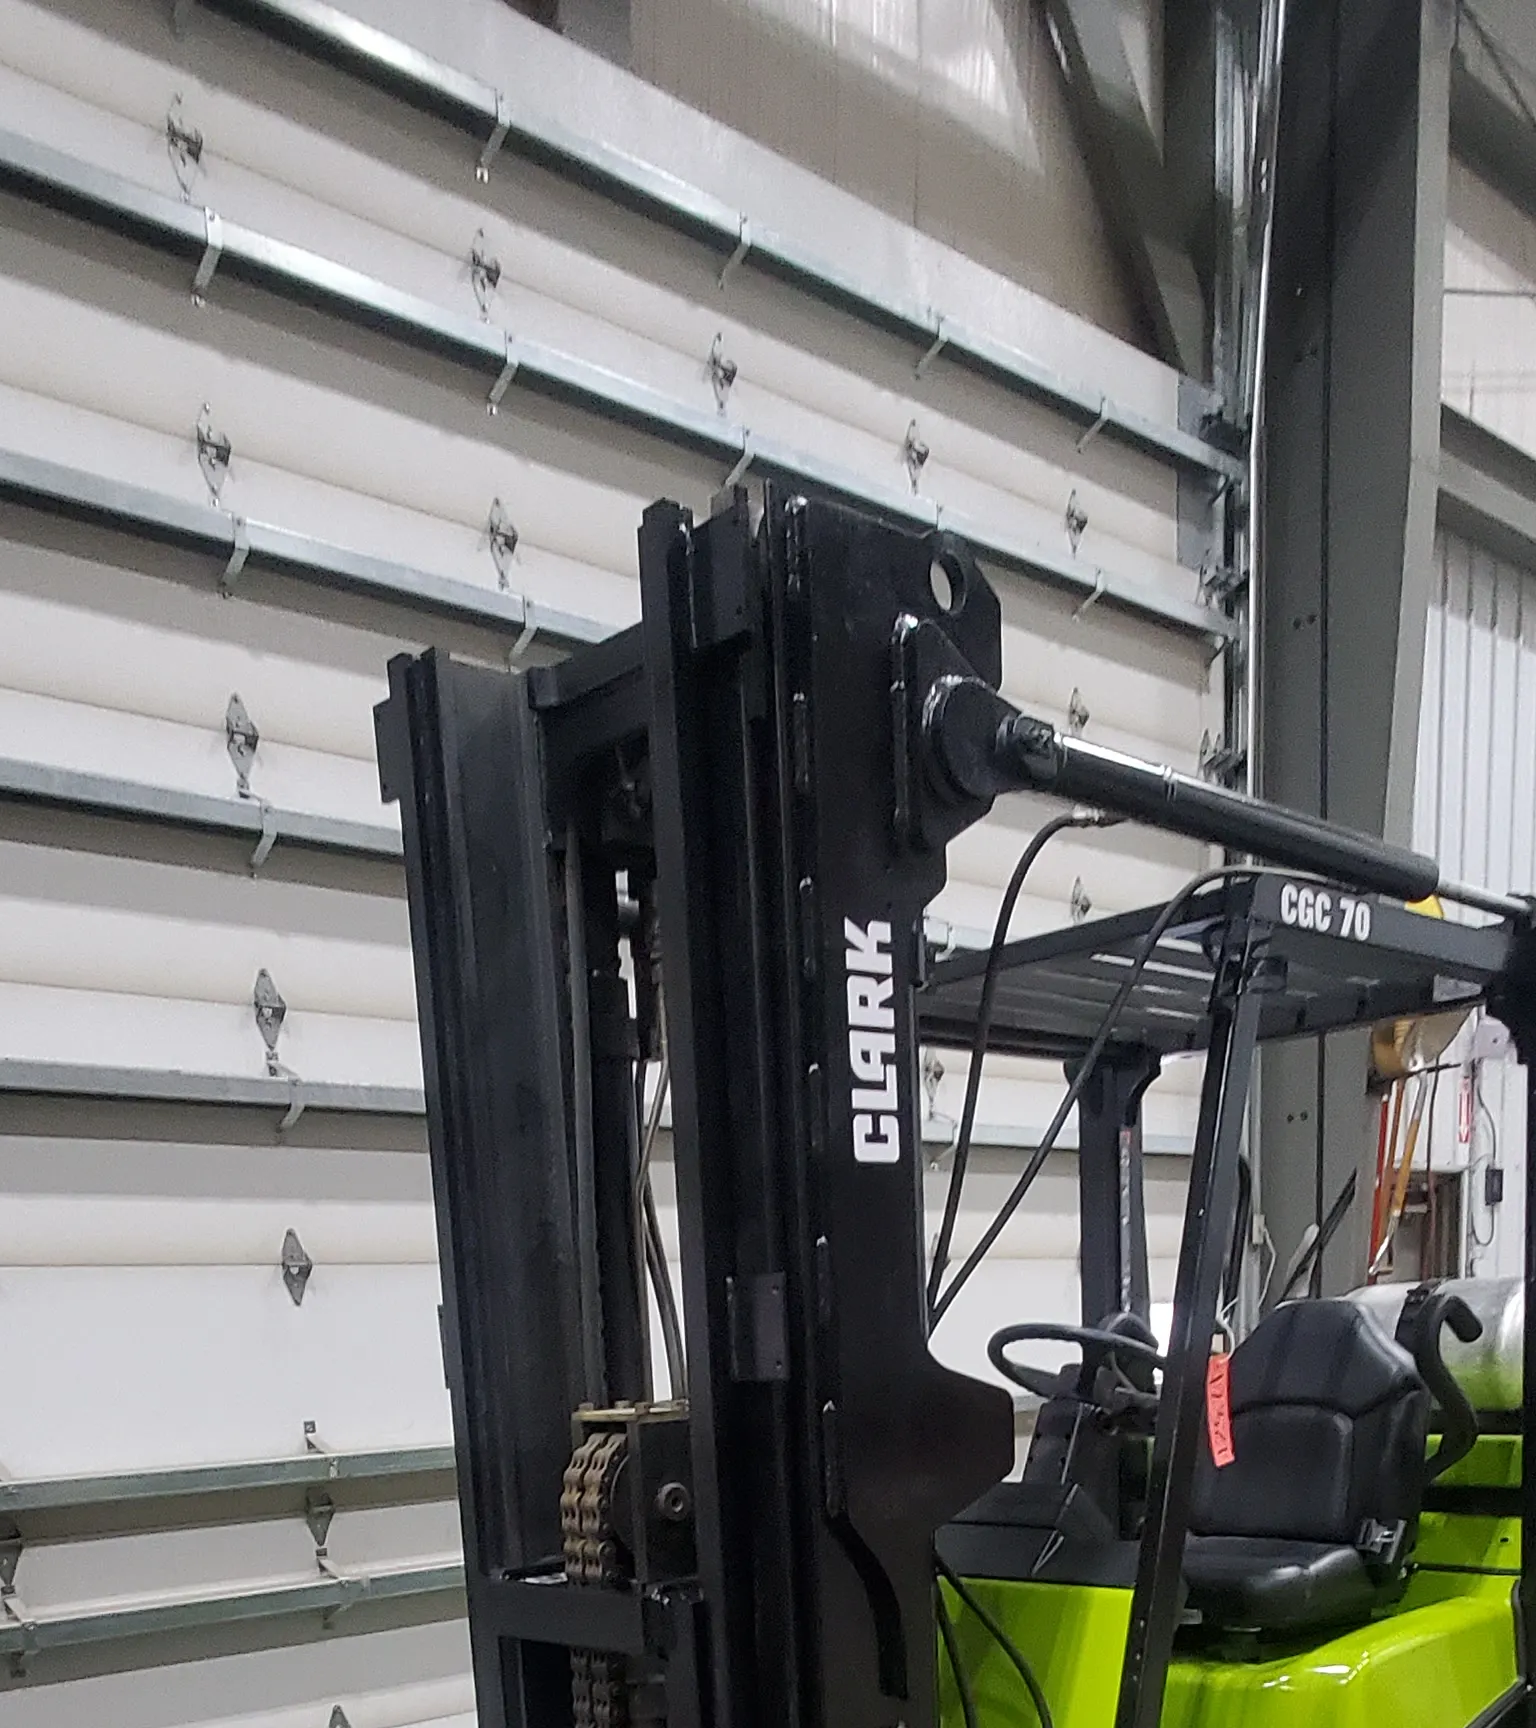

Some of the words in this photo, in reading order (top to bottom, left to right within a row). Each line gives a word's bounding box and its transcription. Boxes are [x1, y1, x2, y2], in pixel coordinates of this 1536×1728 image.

[1281, 883, 1332, 932] CGC
[1340, 897, 1371, 941] 70
[844, 916, 900, 1163] CLARK
